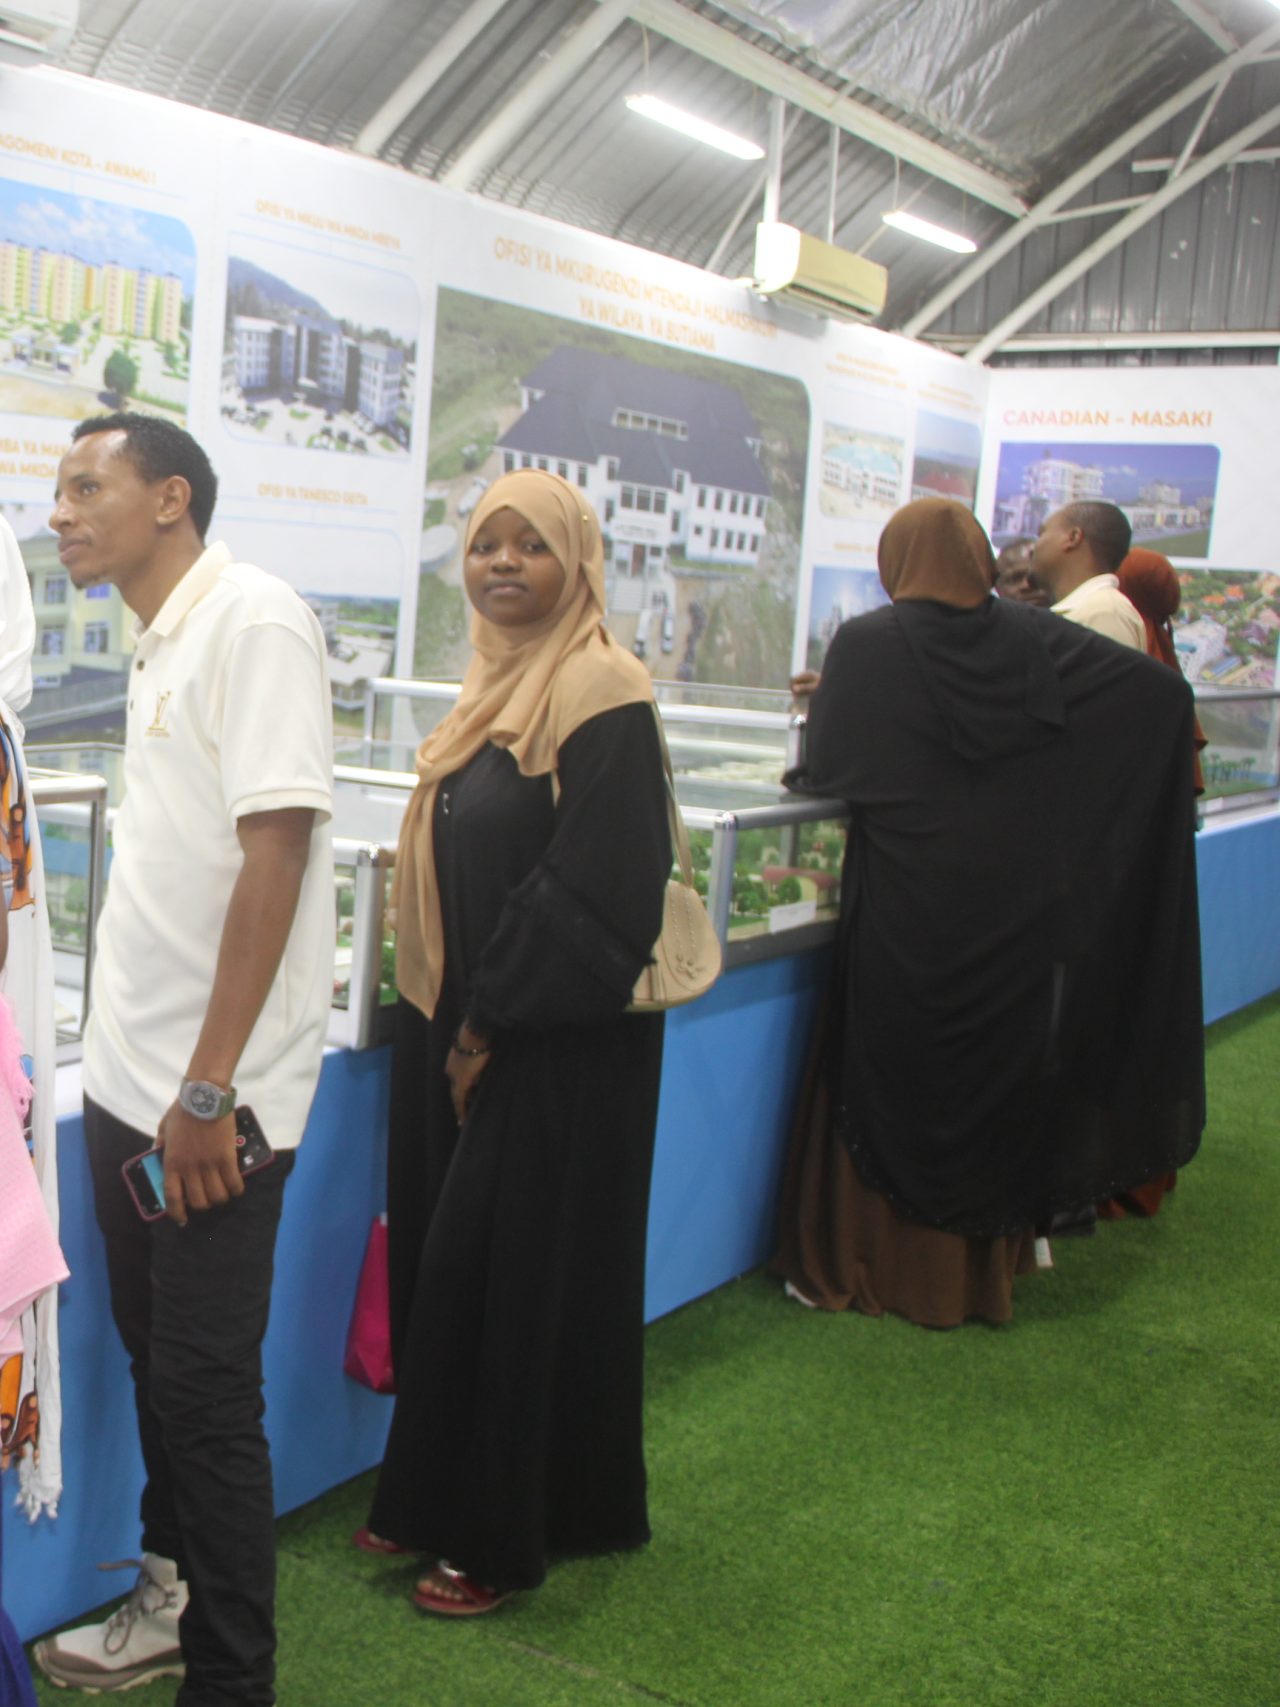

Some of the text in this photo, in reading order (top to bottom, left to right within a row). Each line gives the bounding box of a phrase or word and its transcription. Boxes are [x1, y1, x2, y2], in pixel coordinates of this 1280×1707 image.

[495, 236, 531, 267] OFISI
[536, 249, 552, 273] YA
[579, 294, 595, 319] YA
[598, 301, 644, 331] WILAYA
[649, 315, 663, 336] YA
[1003, 408, 1110, 427] CANADIAN
[1130, 409, 1214, 428] MASAKI
[23, 440, 38, 455] YA
